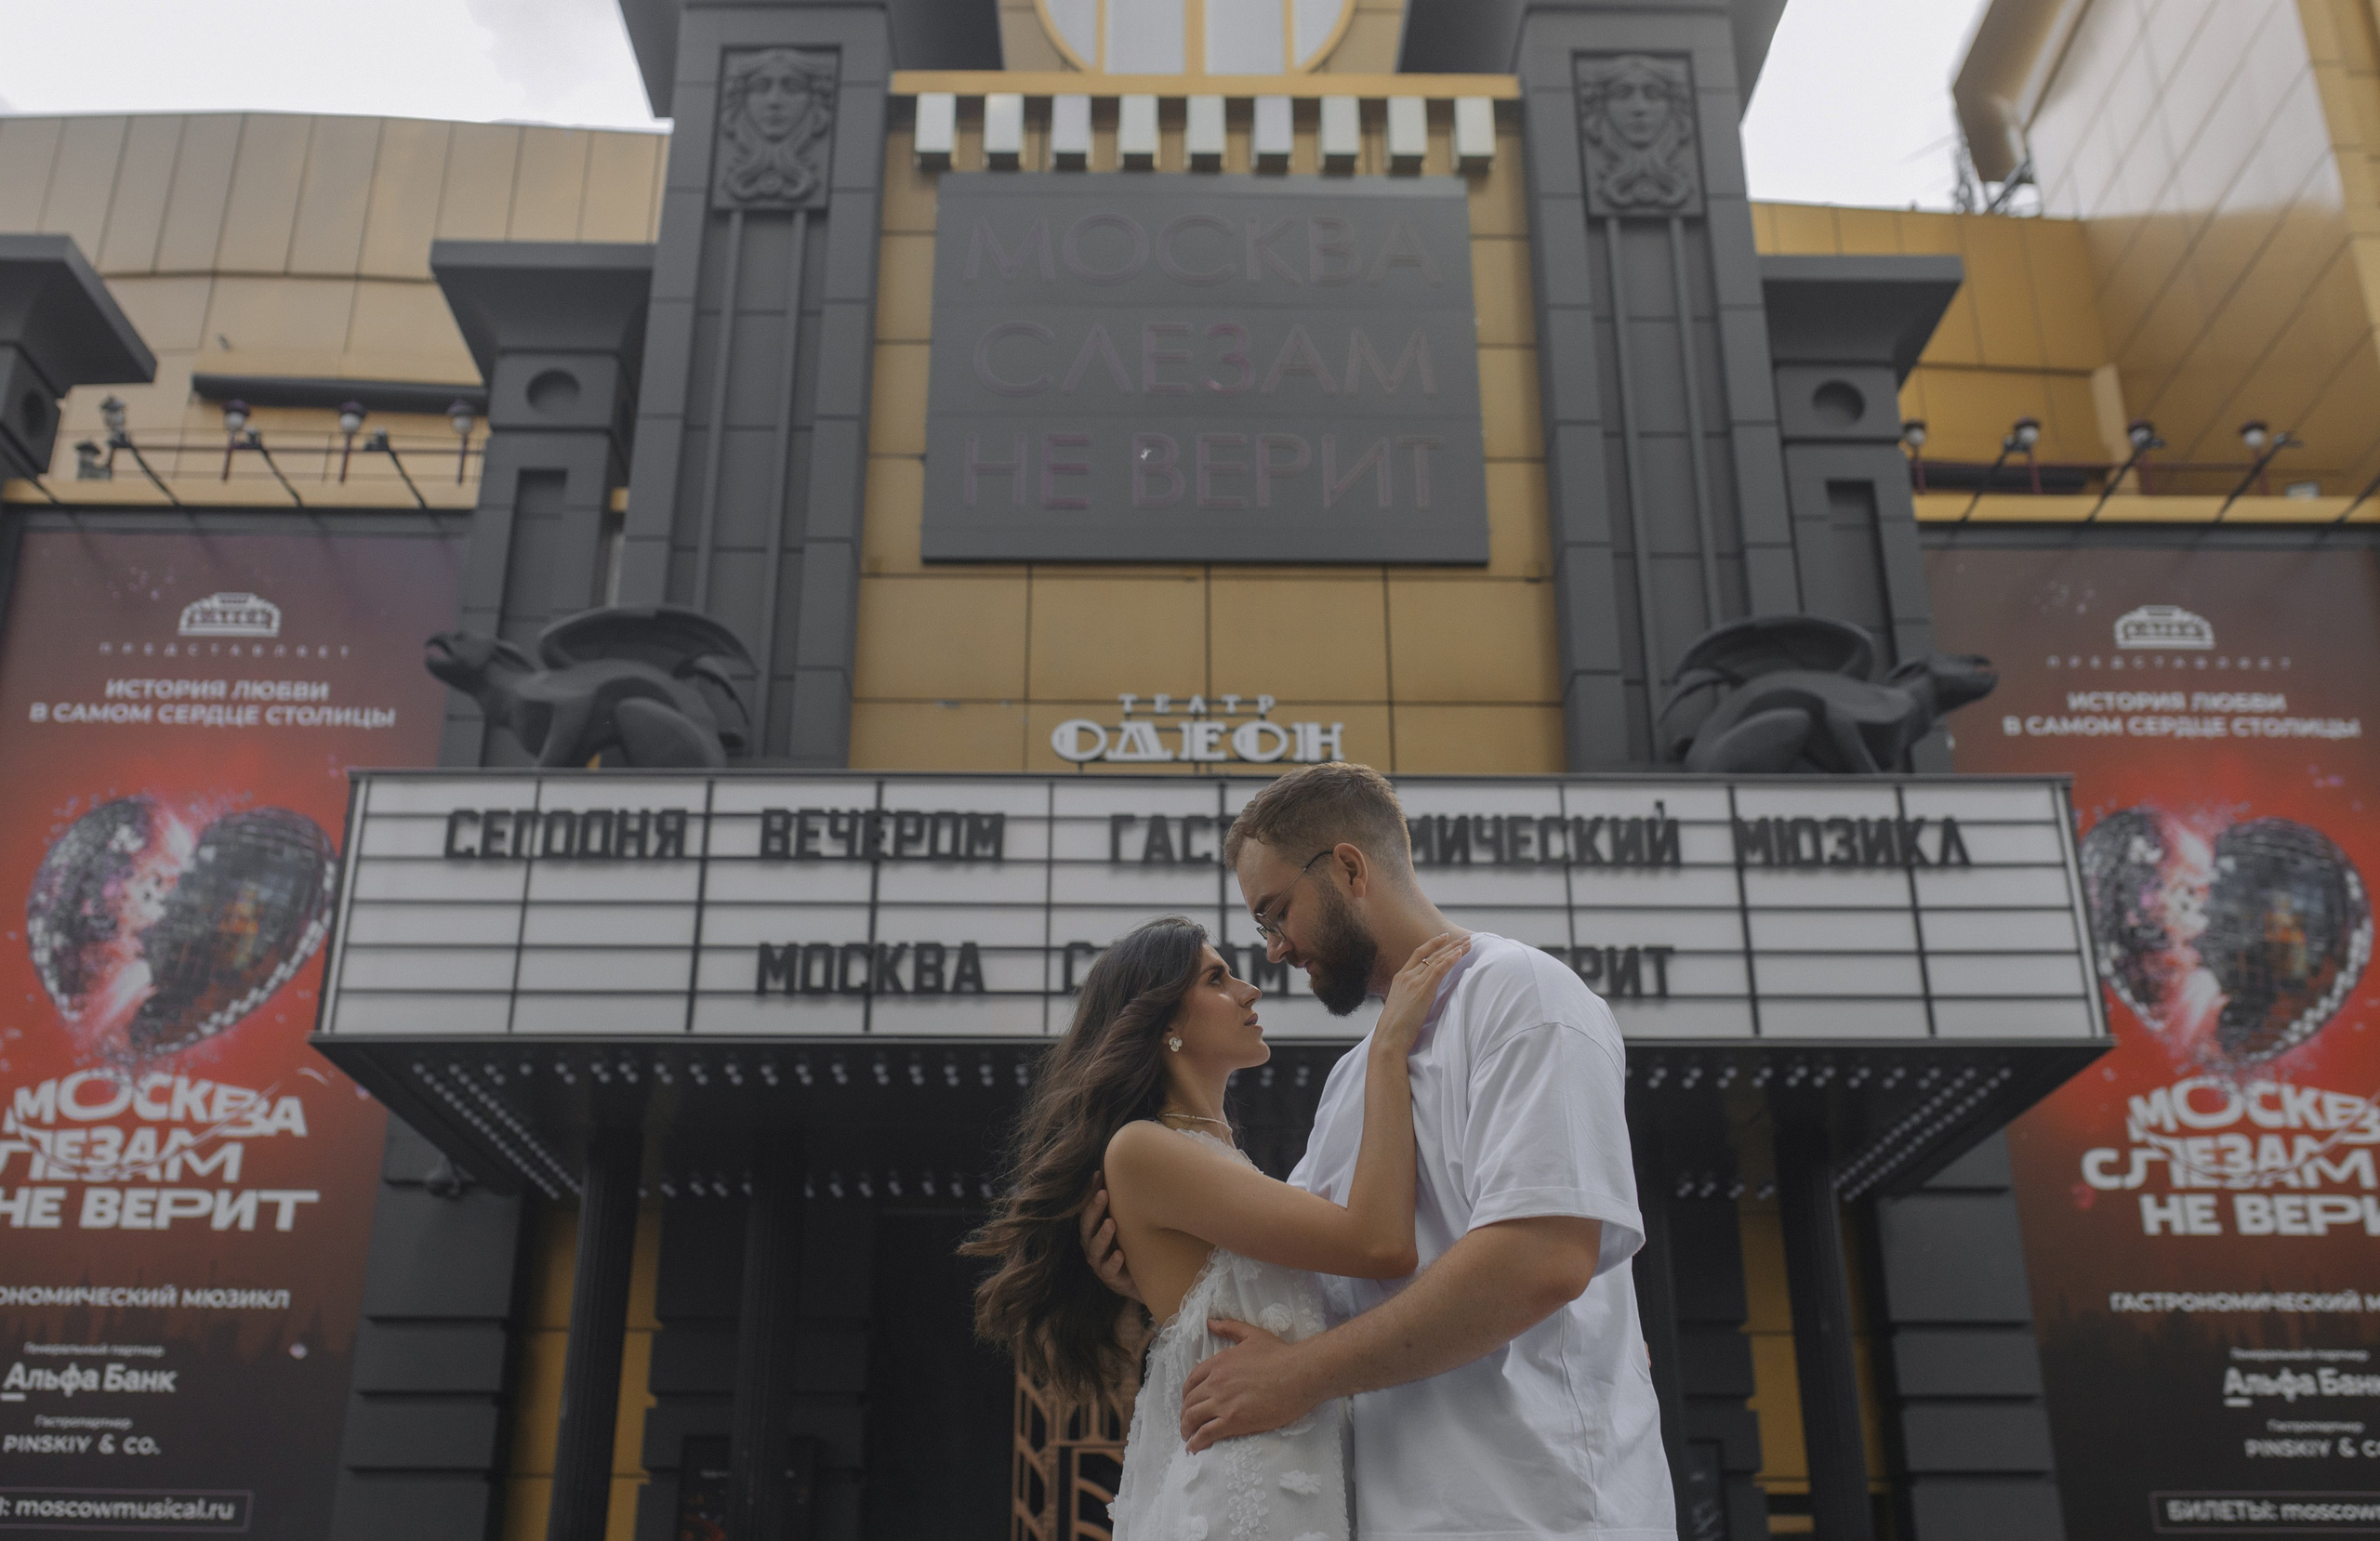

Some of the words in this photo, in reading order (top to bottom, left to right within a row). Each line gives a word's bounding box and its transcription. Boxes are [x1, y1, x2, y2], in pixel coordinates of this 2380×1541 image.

[963, 212, 1443, 288] МОСКВА
[971, 320, 1437, 398] СЛЕЗАМ
[961, 432, 1093, 510] НЕ
[1130, 432, 1445, 511] ВЕРИТ
[104, 678, 226, 700] ИСТОРИЯ
[231, 679, 330, 701] ЛЮБВИ
[1118, 693, 1276, 715] ТЕАТР
[2067, 691, 2186, 712] ИСТОРИЯ
[29, 702, 47, 723] В
[53, 703, 152, 725] САМОМ
[157, 705, 259, 729] СЕРДЦЕ
[265, 706, 397, 731] СТОЛИЦЫ
[2003, 716, 2022, 736] В
[2026, 716, 2123, 737] САМОМ
[1050, 718, 1344, 763] ОДЕОН
[444, 808, 688, 860] СЕГОДНЯ
[760, 808, 1005, 863] ВЕЧЕРОМ
[1110, 799, 1682, 868] ГАСМИЧЕСКИЙ
[1735, 814, 1972, 868] МЮЗИКЛ
[754, 941, 986, 995] МОСКВА
[1539, 945, 1674, 999] РИТ
[2, 1068, 309, 1139] МОСКВА
[2127, 1074, 2380, 1144] МОСКВ
[0, 1123, 244, 1182] ЛЕЗАМ
[2081, 1132, 2377, 1191] СЛЕЗАМ
[78, 1187, 321, 1231] ВЕРИТ
[2139, 1193, 2223, 1235] НЕ
[2234, 1193, 2380, 1236] ВЕР
[181, 1288, 291, 1310] МЮЗИКЛ
[2, 1362, 99, 1398] Альфа
[103, 1363, 178, 1393] Банк
[2318, 1367, 2380, 1396] Бан
[98, 1433, 116, 1455] &
[15, 1497, 235, 1521] moscowmusical.ru
